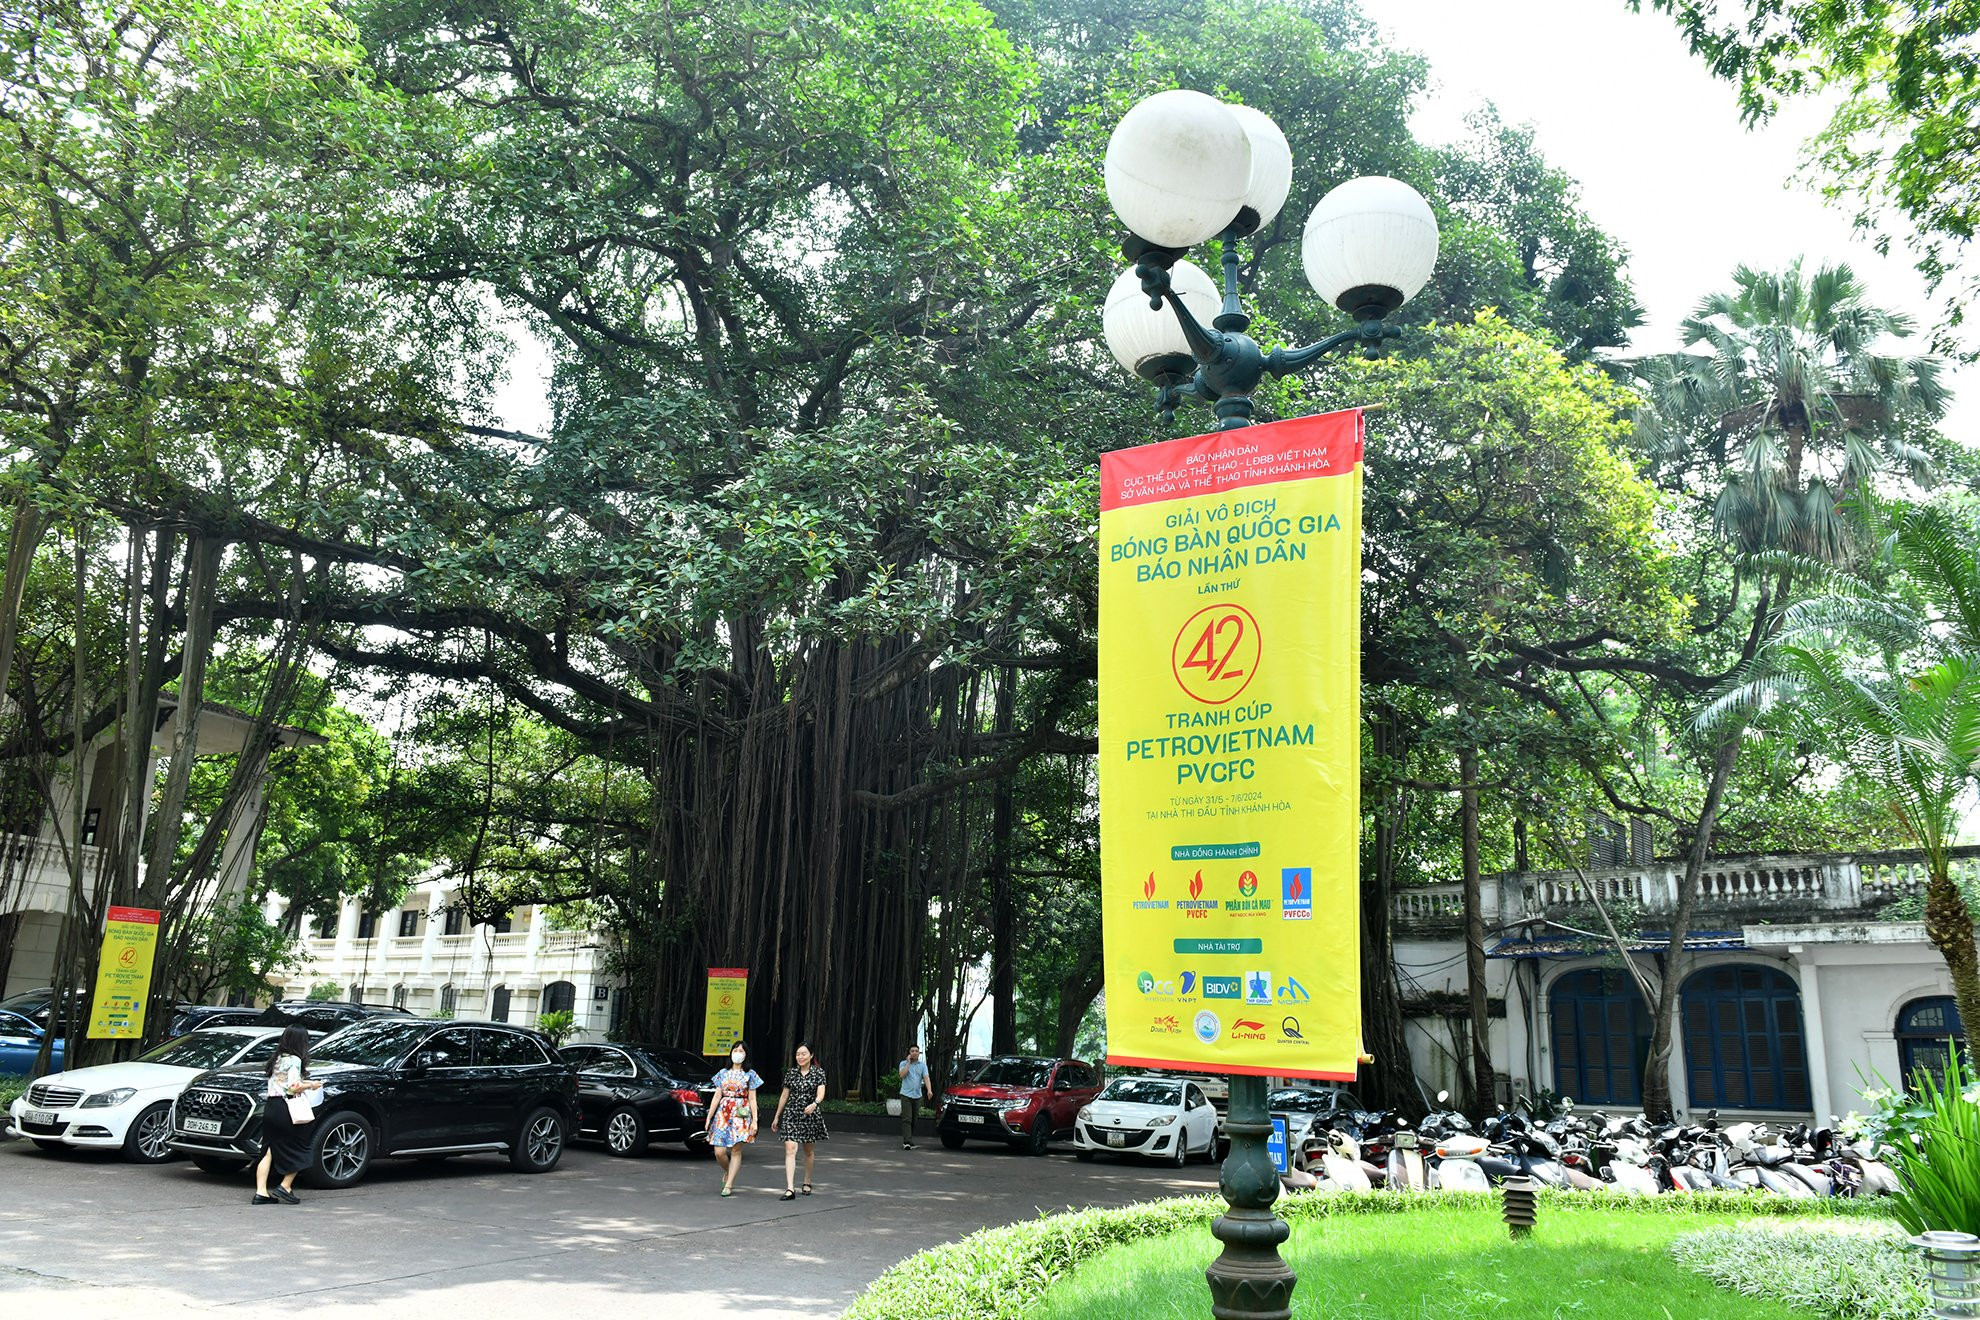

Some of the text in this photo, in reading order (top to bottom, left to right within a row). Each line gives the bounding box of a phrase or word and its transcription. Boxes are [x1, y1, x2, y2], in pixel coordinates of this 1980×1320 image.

[1186, 445, 1259, 465] BÁO NHÂN DÂN
[1123, 476, 1144, 488] CỤC
[1146, 469, 1165, 483] THỂ
[1166, 469, 1187, 481] DỤC
[1190, 462, 1209, 476] THỂ
[1211, 460, 1237, 473] THAO
[1246, 454, 1274, 467] LĐBB
[1276, 449, 1301, 461] VIỆT
[1303, 446, 1327, 458] NAM
[1120, 458, 1331, 500] SỞ VĂN HÓA VÀ THỂ THAO TỈNH KHÁNH HÒA
[1165, 498, 1277, 528] GIẢI VÔ ĐỊCH
[1110, 513, 1341, 563] BÓNG BÀN QUỐC GIA
[1136, 538, 1306, 583] BÁO NHÂN DÂN
[1220, 578, 1241, 593] THỨ
[1181, 614, 1244, 682] 42
[1165, 700, 1273, 729] TRANH CÚP
[1126, 723, 1315, 761] PETROVIETNAM
[1177, 758, 1255, 785] PVCFC
[1170, 795, 1182, 806] TỪ
[1183, 794, 1204, 806] NGÀY
[1205, 795, 1224, 805] 31/5
[1231, 791, 1262, 803] 7/6/2024
[1146, 800, 1292, 822] TẠI NHÀ THI ĐẤU TỈNH KHÁNH HÒA
[1174, 844, 1259, 858] NHÀ ĐỒNG HÀNH CHÍNH
[1132, 900, 1170, 909] PETROVIETNAM
[1176, 899, 1219, 910] PETROVIETNAM
[1186, 909, 1208, 919] PVCFC
[1283, 910, 1311, 918] PVFCCo
[1197, 941, 1241, 952] NHÀ TÀI TRỢ
[121, 949, 135, 963] 42
[597, 987, 606, 998] B
[1143, 979, 1174, 995] BCG
[1205, 982, 1230, 995] BIDV
[1231, 1032, 1266, 1041] LI-NING
[1274, 1131, 1283, 1144] XE
